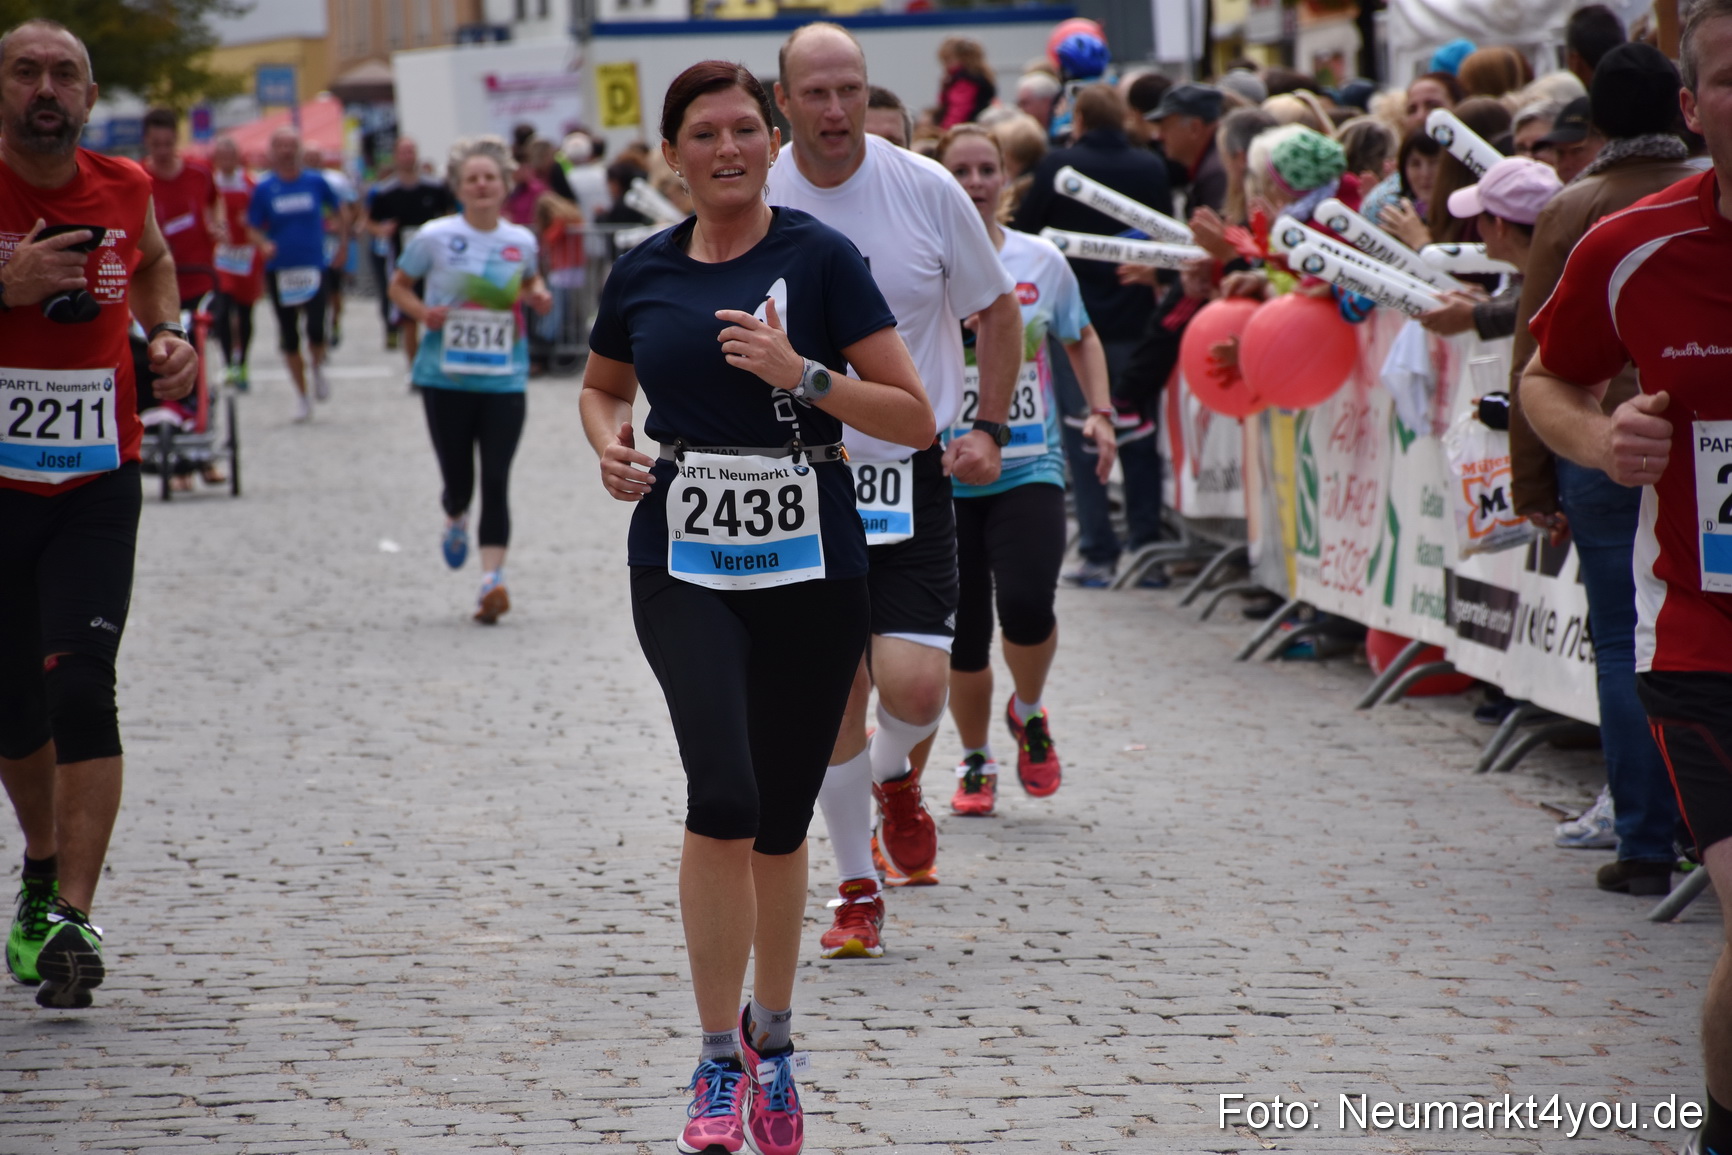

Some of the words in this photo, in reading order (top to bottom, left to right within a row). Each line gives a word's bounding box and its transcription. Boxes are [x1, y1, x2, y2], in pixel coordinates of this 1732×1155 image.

[607, 83, 632, 115] D
[452, 324, 505, 349] 2614
[46, 381, 101, 393] Neumarkt
[8, 396, 105, 440] 2211
[36, 451, 82, 468] Josef
[719, 468, 790, 481] Neumarkt
[682, 484, 805, 537] 2438
[1479, 487, 1508, 520] M
[710, 551, 779, 571] Verena
